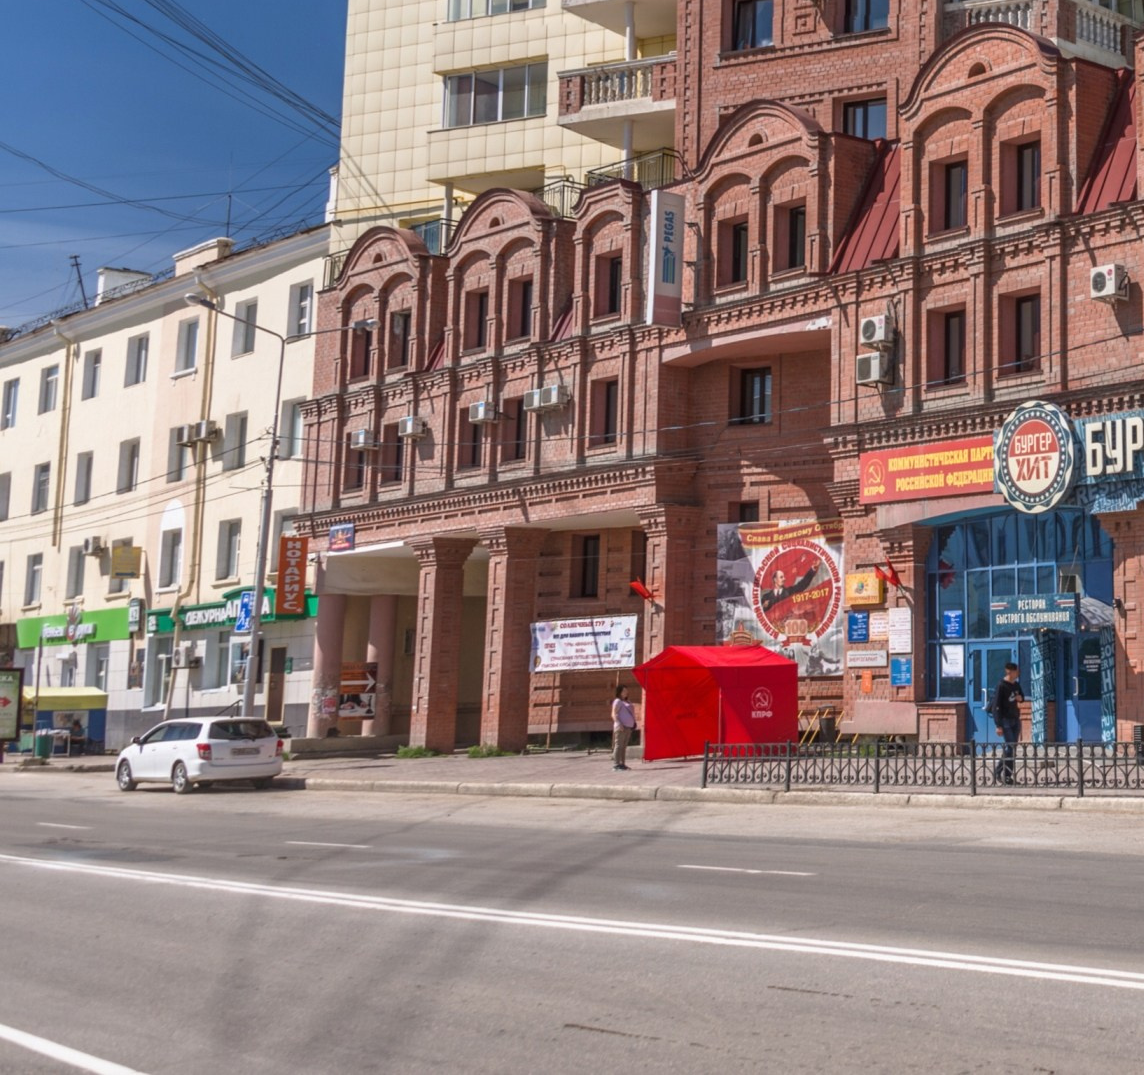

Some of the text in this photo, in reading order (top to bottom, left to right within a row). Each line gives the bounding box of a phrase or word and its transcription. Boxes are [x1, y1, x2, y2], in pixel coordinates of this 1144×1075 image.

[664, 210, 674, 243] PEGAS
[1014, 432, 1052, 455] БУРГЕР
[888, 449, 968, 472] КОММУНИСТИЧЕСКАЯ
[1015, 455, 1053, 482] ХИТ
[864, 485, 885, 496] КПРФ
[896, 471, 944, 492] РОССИЙСКОЙ
[746, 533, 771, 543] Слава
[773, 527, 812, 542] Великому
[283, 541, 301, 609] НОТАРИУС
[792, 588, 829, 604] 1917-2017
[1018, 599, 1046, 610] РЕСТОРАН
[226, 596, 270, 618] АПА
[996, 611, 1070, 624] БЫСТРОГО ОБСЛУЖИВАНИЯ
[751, 710, 773, 719] КПРФ
